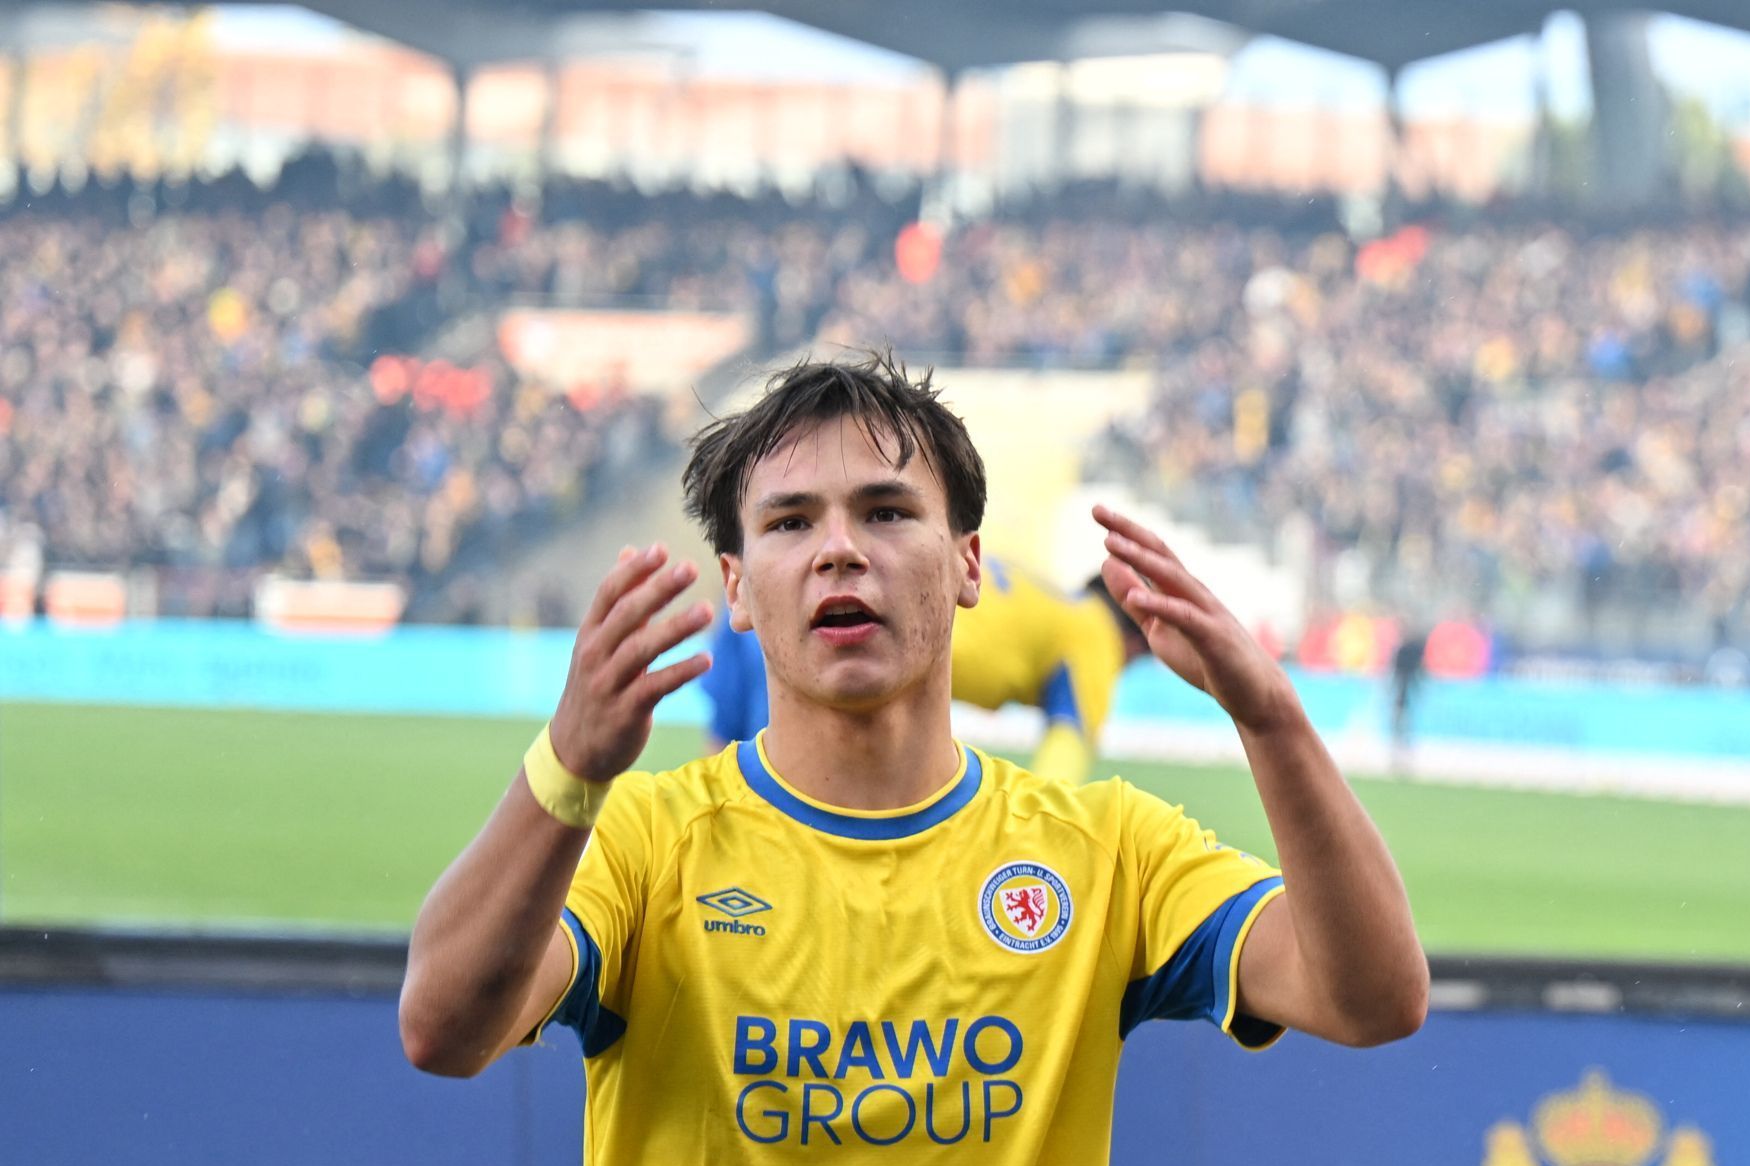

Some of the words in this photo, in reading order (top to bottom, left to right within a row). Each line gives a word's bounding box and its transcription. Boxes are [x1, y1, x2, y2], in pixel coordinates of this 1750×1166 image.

[704, 919, 766, 936] umbro
[999, 933, 1039, 950] EINTRACHT
[733, 1015, 1024, 1080] BRAWO
[735, 1080, 1024, 1146] GROUP
